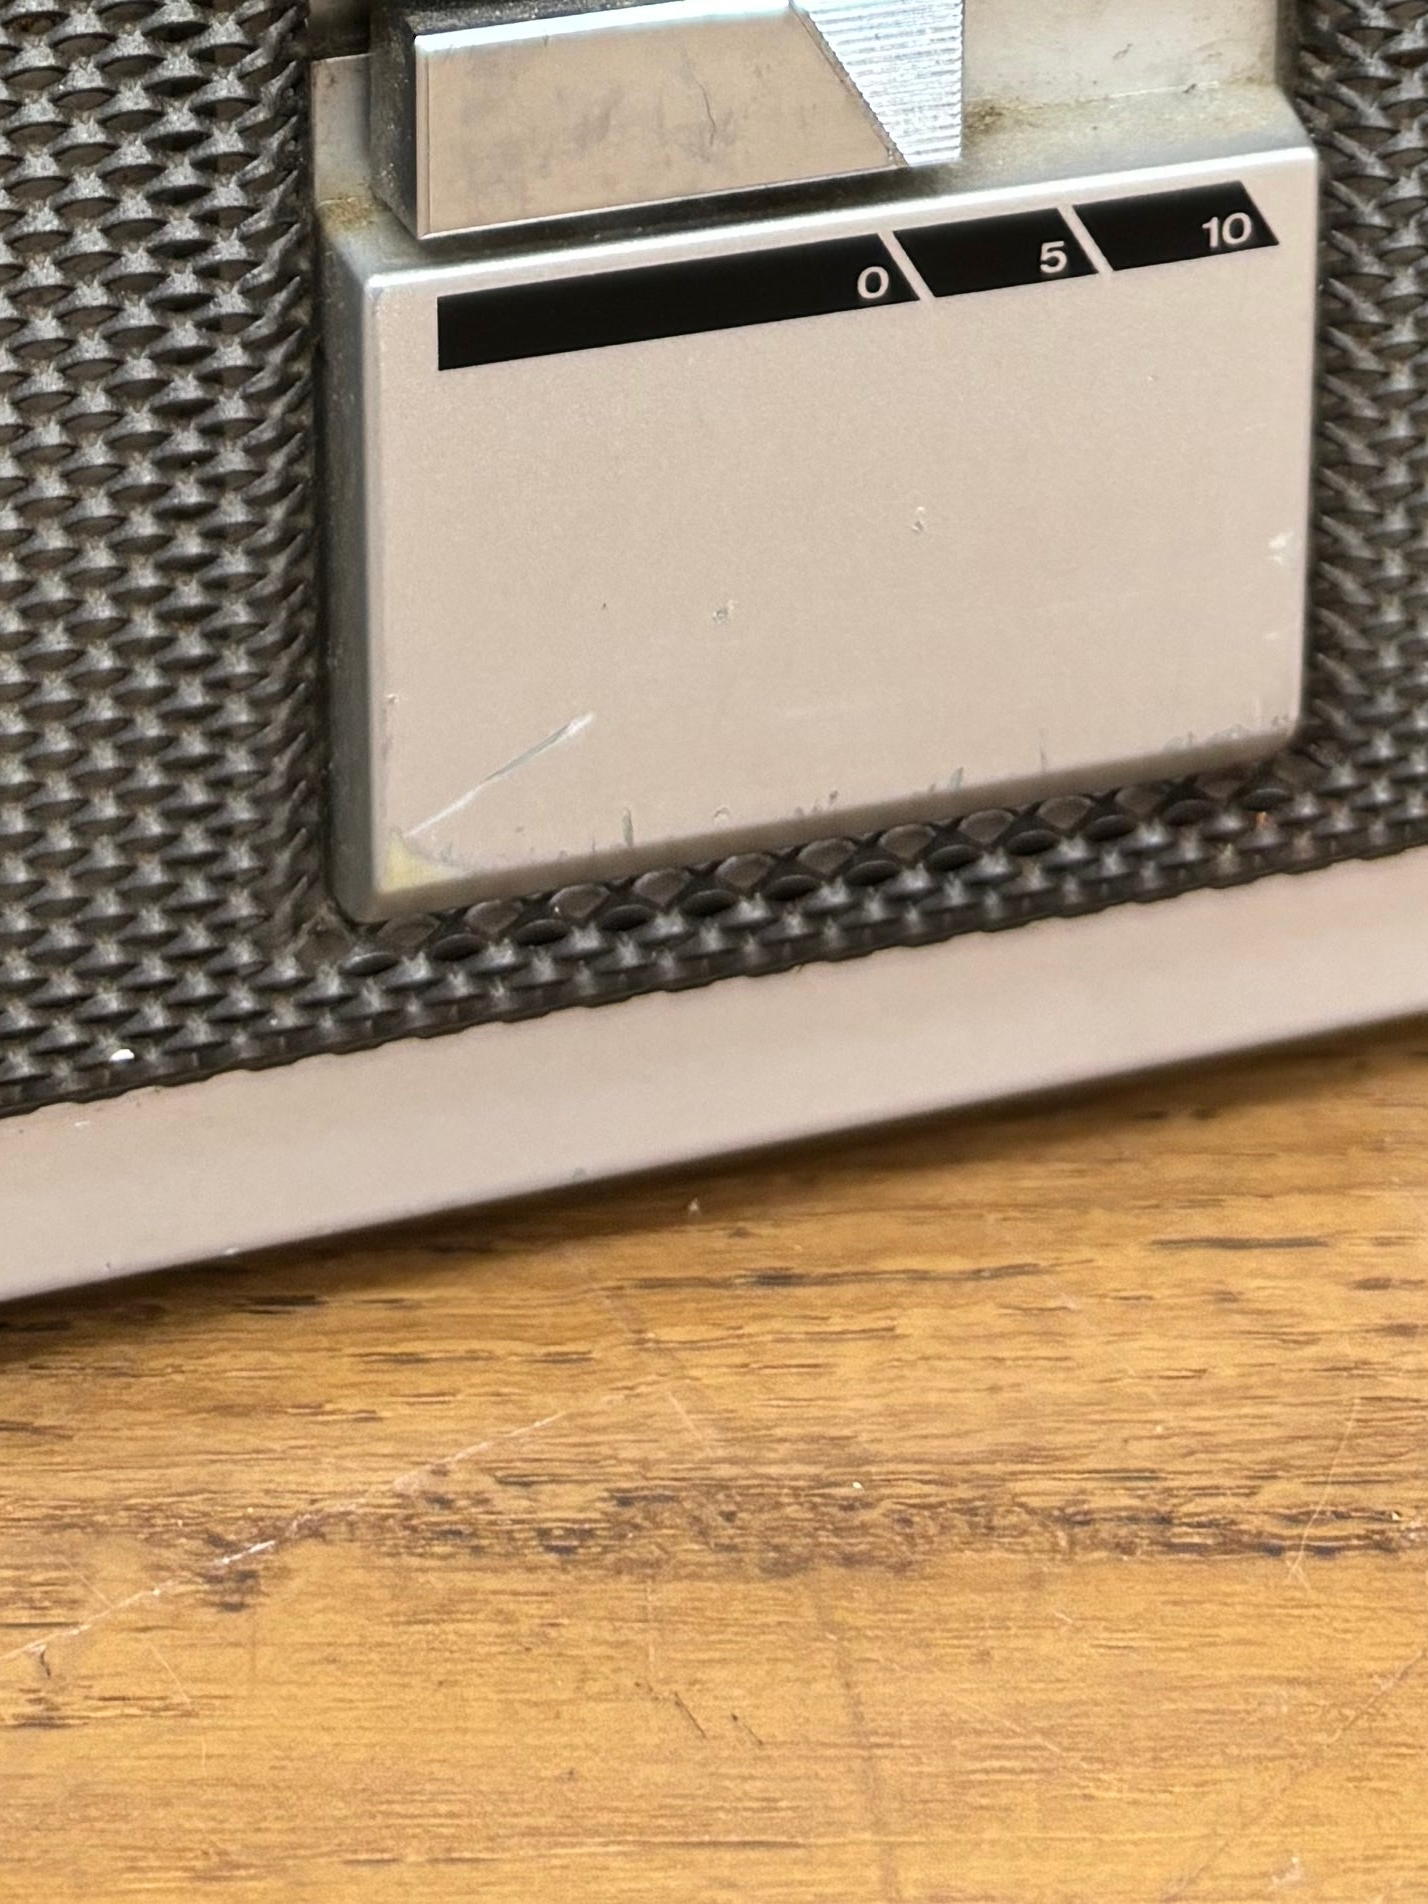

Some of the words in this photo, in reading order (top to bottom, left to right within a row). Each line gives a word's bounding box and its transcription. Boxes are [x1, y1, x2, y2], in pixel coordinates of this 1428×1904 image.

[1201, 211, 1253, 251] 10
[1038, 240, 1068, 275] 5
[855, 265, 890, 300] 0
